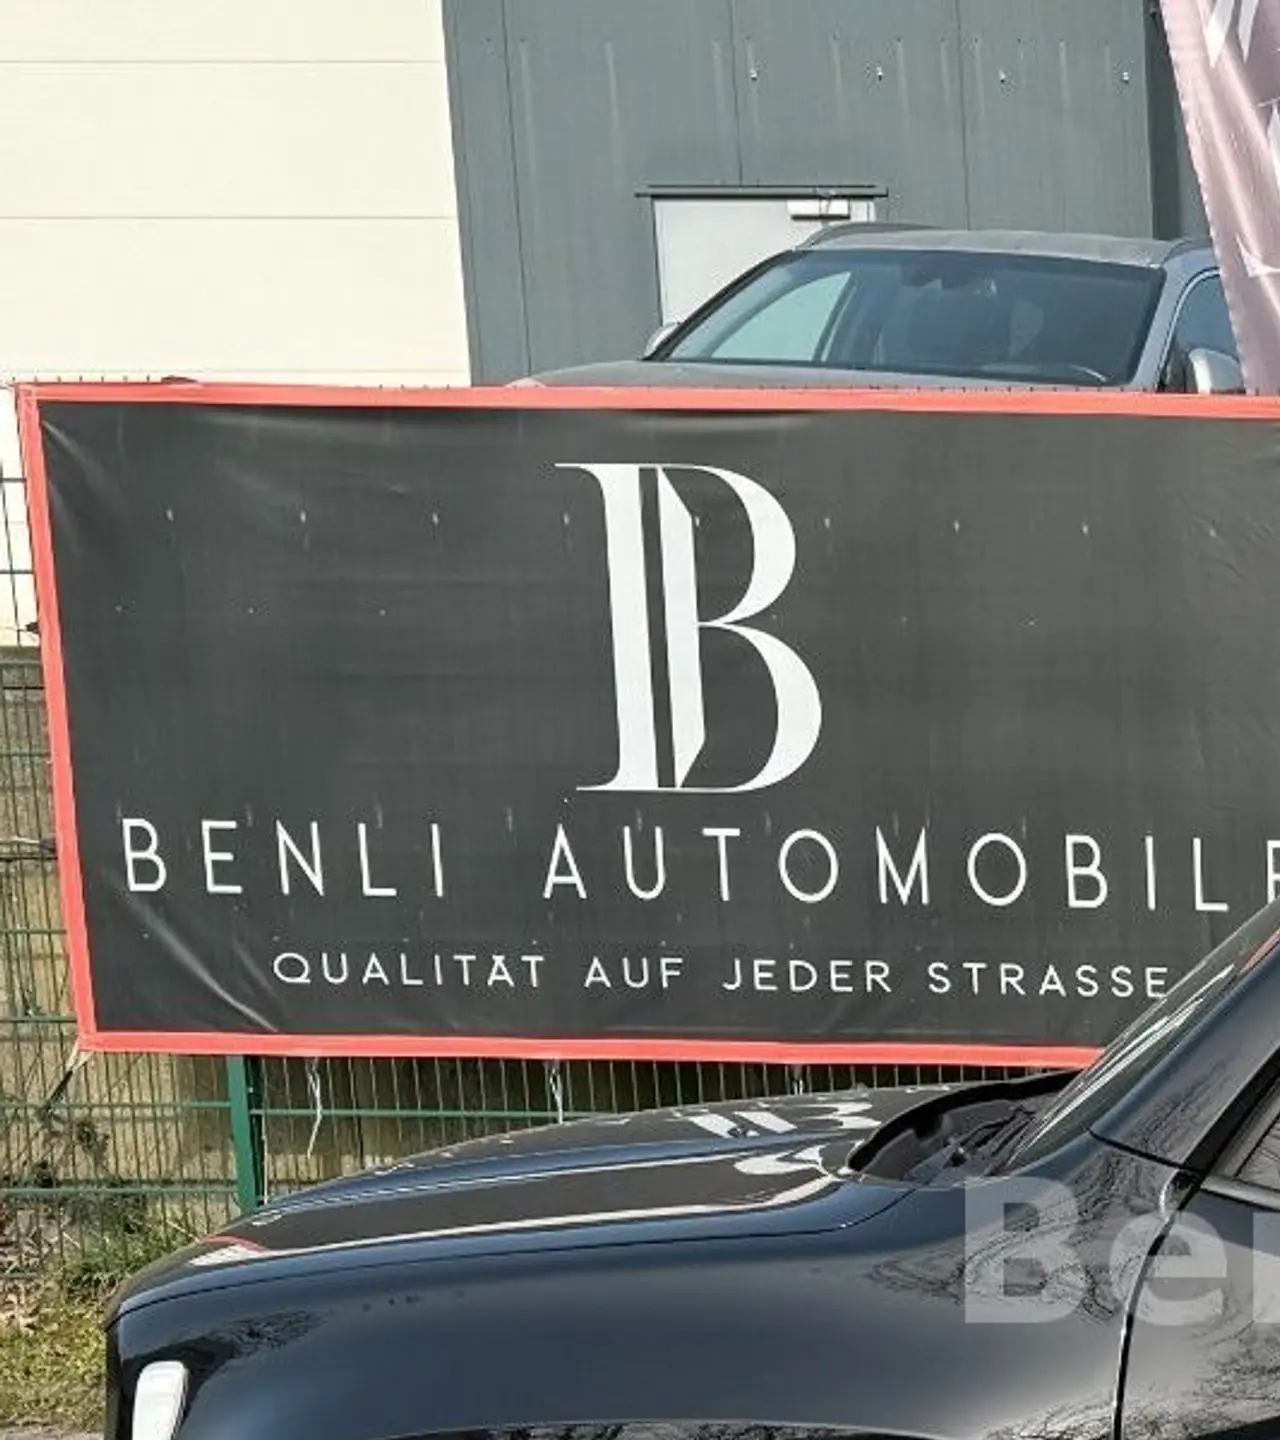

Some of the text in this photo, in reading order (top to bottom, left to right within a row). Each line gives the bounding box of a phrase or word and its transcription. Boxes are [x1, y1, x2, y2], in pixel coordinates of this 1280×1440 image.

[122, 818, 444, 897] BENLI
[273, 952, 1169, 1000] QUALITÄT AUF JEDER STRASSE
